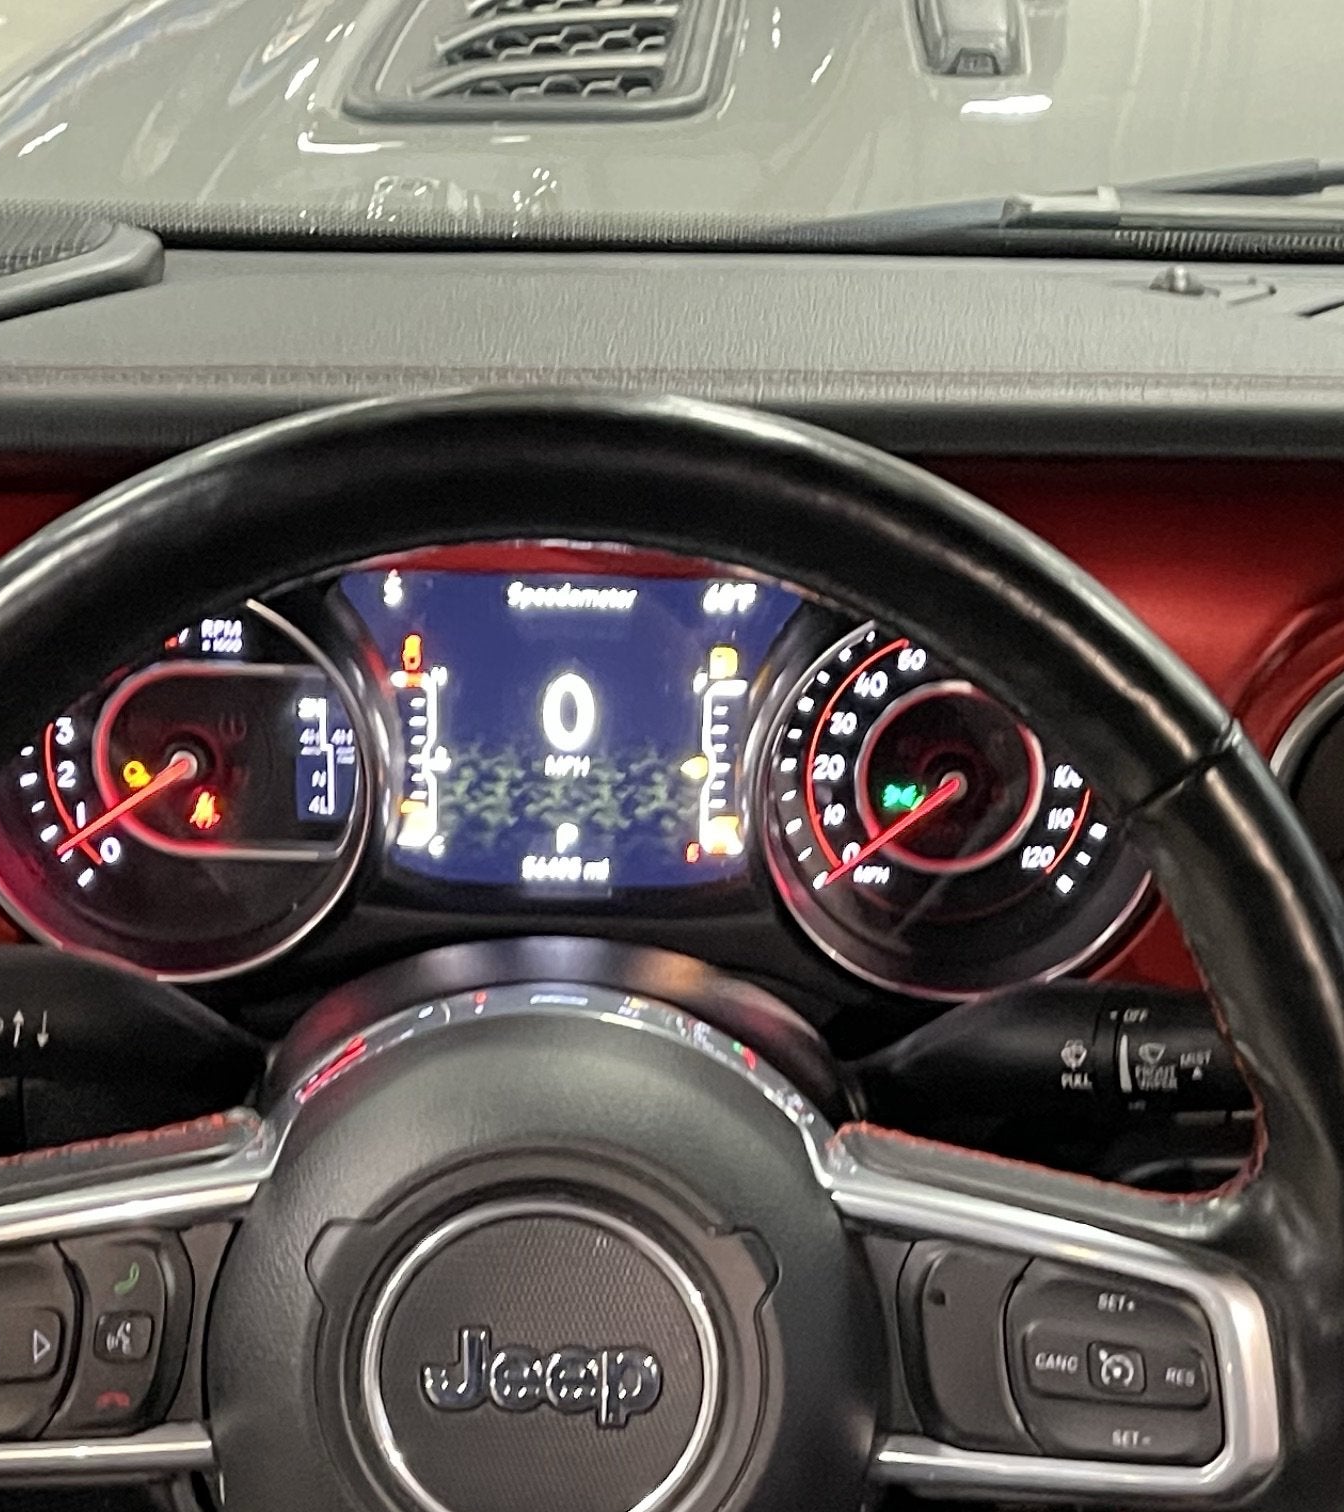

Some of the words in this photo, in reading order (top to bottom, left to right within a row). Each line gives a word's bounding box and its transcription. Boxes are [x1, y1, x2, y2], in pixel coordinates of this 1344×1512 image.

[507, 581, 638, 610] Speedometer
[854, 670, 889, 698] 40
[542, 673, 595, 751] 0
[55, 717, 75, 745] 3
[56, 760, 77, 788] 2
[544, 754, 591, 778] MPH
[812, 753, 846, 781] 20
[76, 801, 86, 829] 1
[823, 803, 846, 826] 10
[1047, 807, 1075, 830] 110
[99, 836, 121, 864] 0
[555, 826, 579, 854] P
[1021, 845, 1056, 869] 120
[1034, 1352, 1078, 1373] CANC
[420, 1325, 663, 1430] Jeep
[1165, 1367, 1195, 1387] RES
